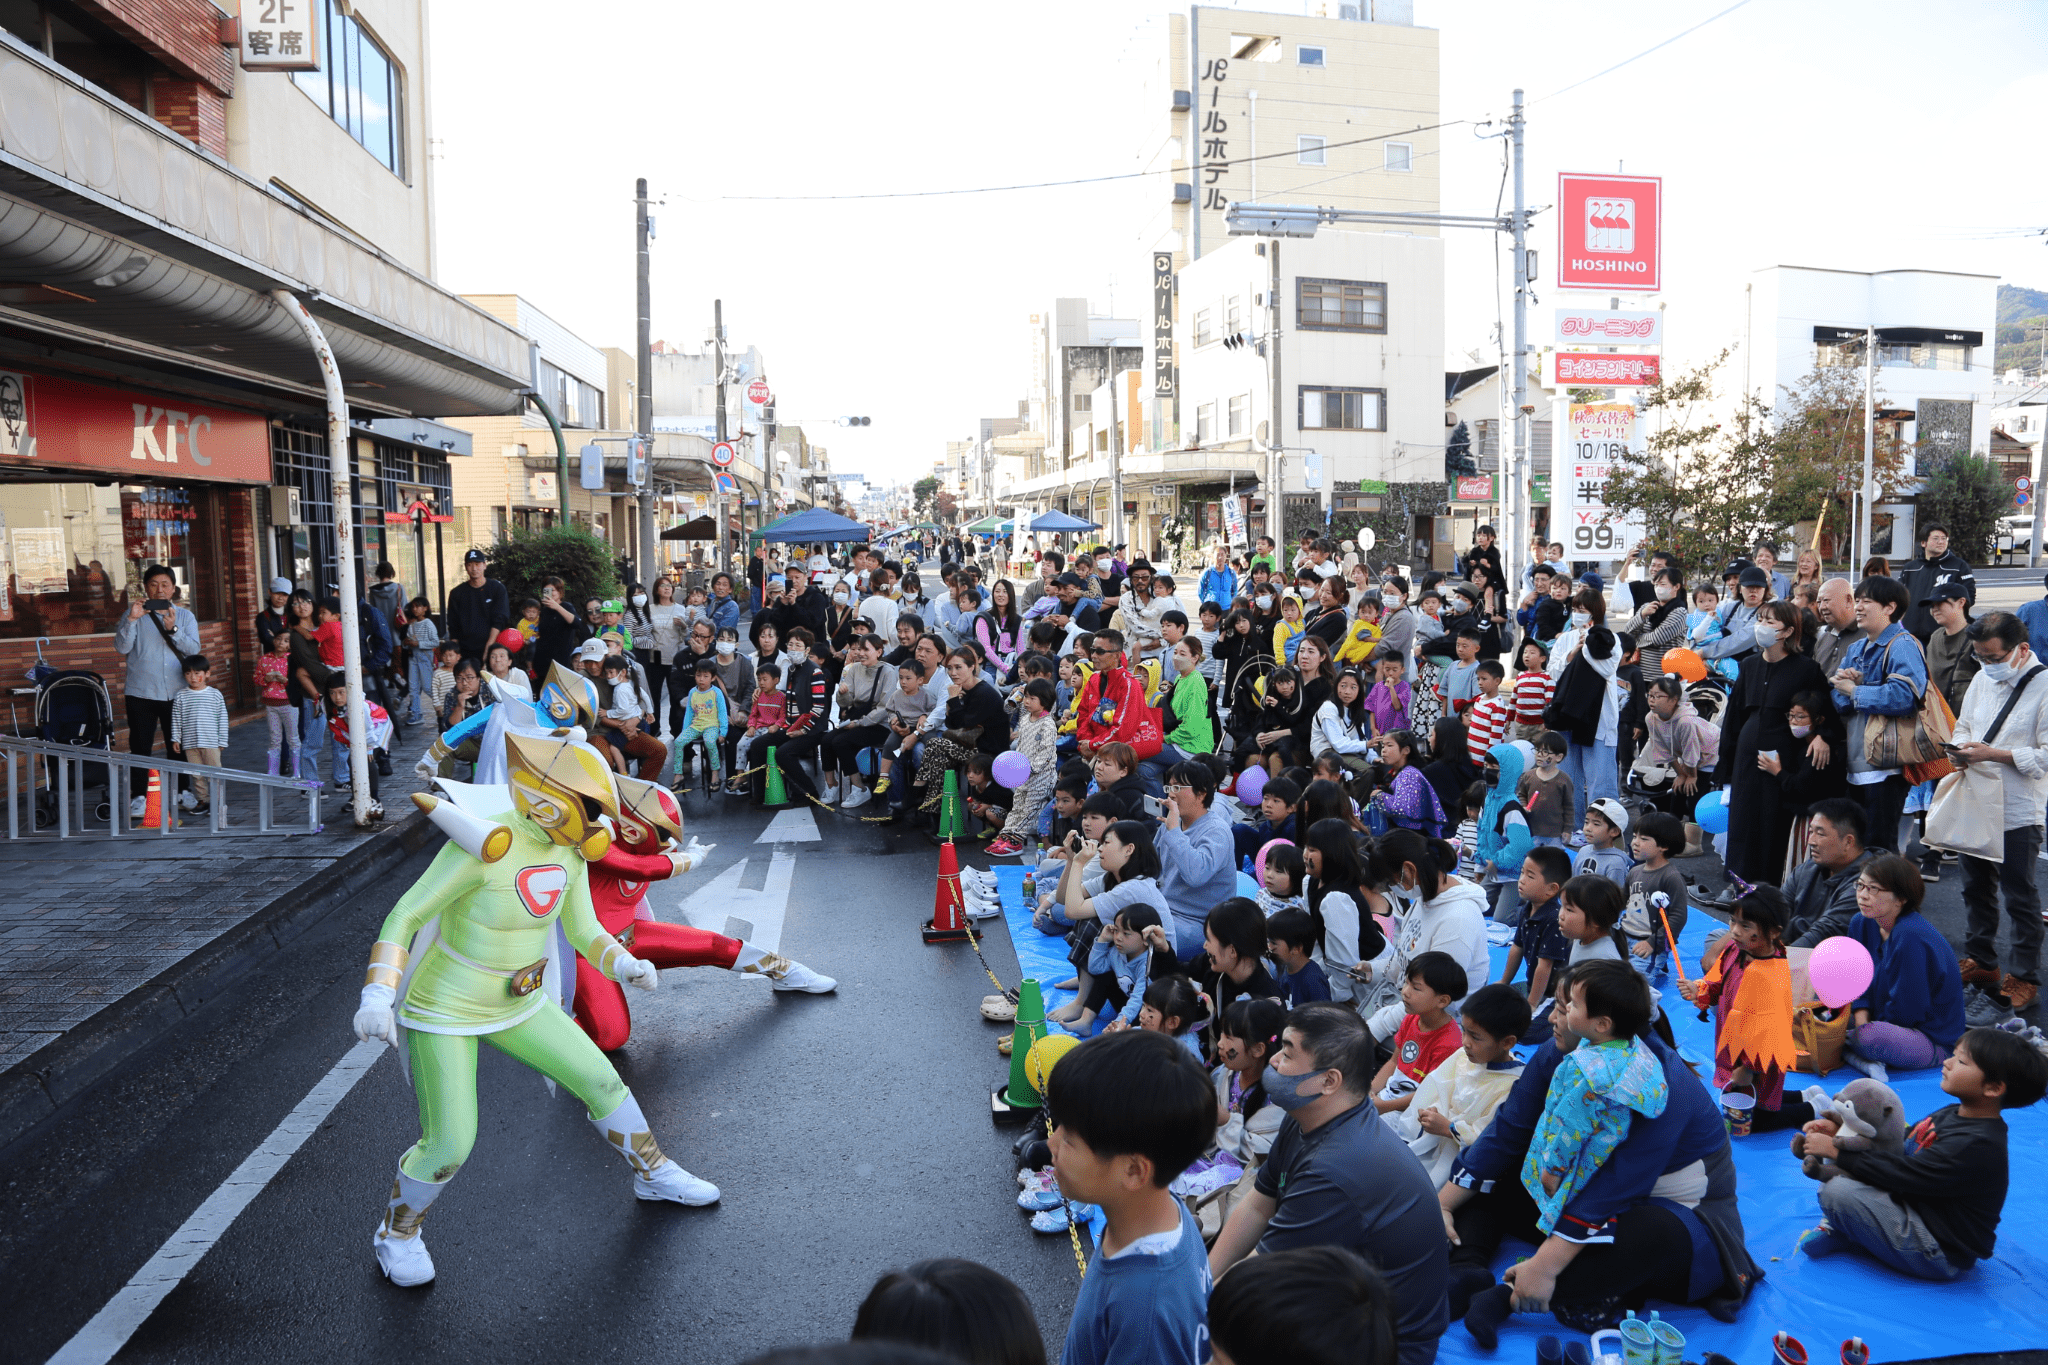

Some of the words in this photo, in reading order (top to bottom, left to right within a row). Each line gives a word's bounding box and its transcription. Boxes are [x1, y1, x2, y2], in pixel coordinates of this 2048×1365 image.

[248, 30, 303, 55] 客席
[1202, 58, 1228, 211] パールホテル
[1571, 258, 1648, 273] HOSHINO
[1155, 274, 1172, 391] パールホテル
[1560, 317, 1656, 338] クリーニング
[1559, 358, 1656, 380] コインランドリー
[748, 388, 770, 398] 消火栓
[1574, 411, 1629, 425] 秋の衣替え
[130, 404, 212, 467] KFC
[716, 449, 730, 460] 40
[2018, 480, 2028, 488] 30
